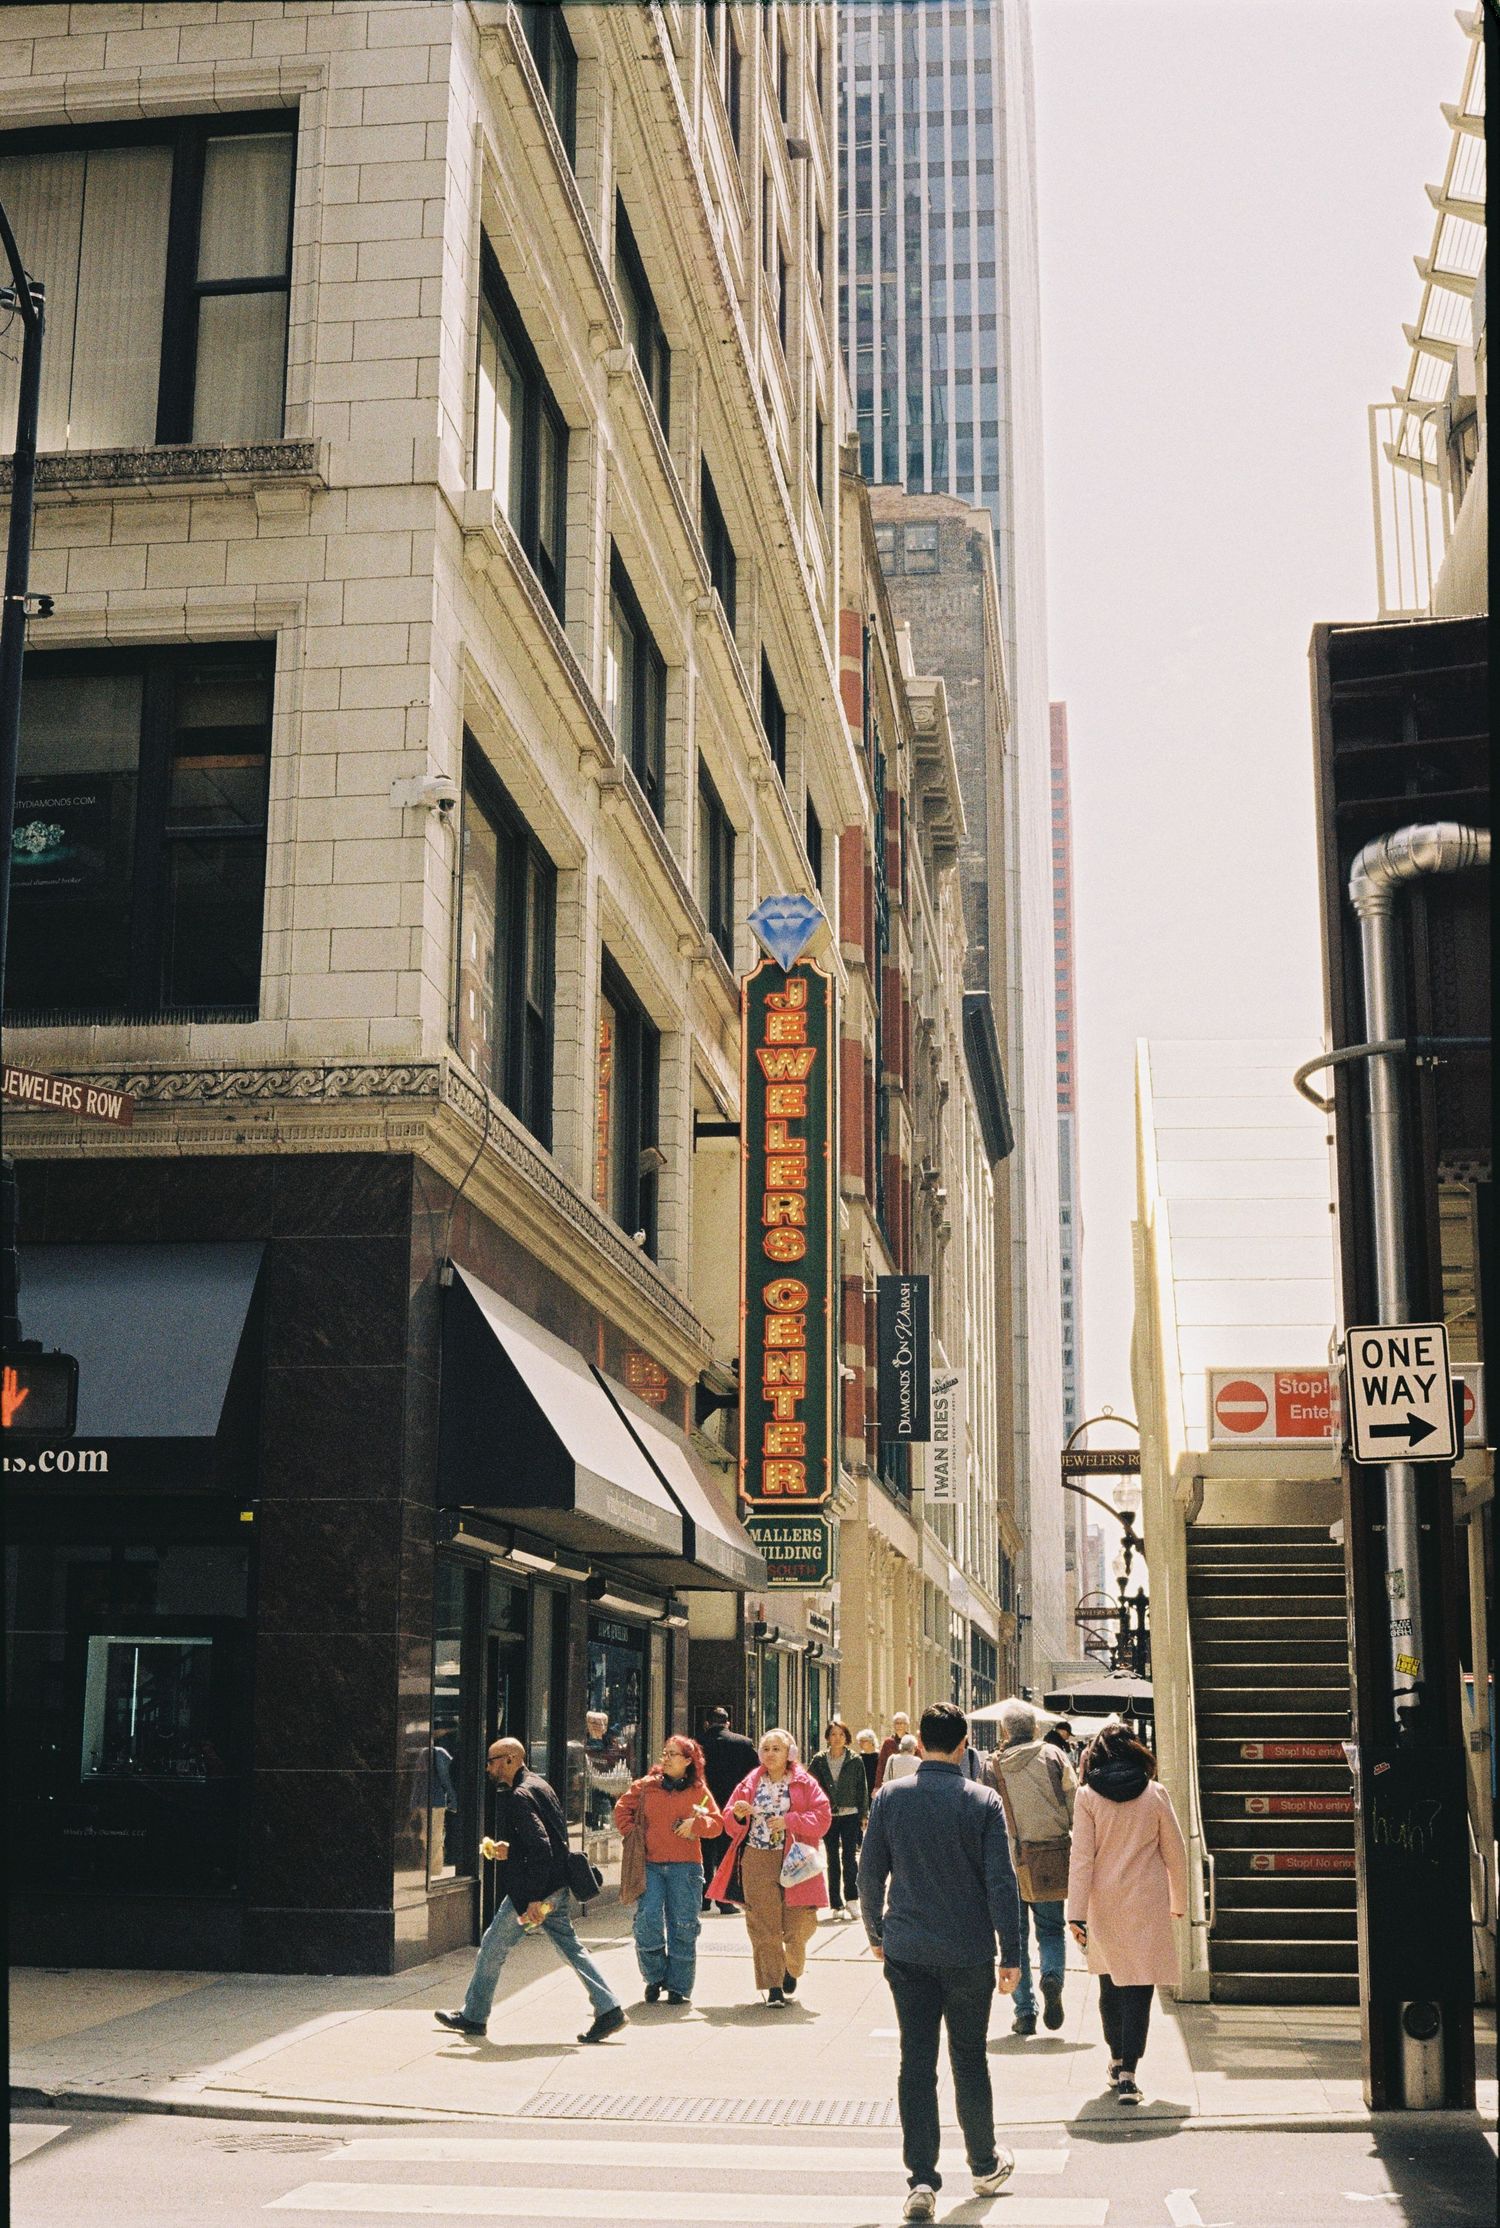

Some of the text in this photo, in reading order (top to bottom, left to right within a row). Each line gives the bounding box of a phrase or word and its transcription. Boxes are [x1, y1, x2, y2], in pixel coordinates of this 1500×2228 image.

[1, 1069, 122, 1119] JEWELERS ROW
[756, 978, 817, 1494] JEWELERS CENTER
[1362, 1336, 1435, 1369] ONE
[1279, 1378, 1328, 1398] Stop!
[1361, 1373, 1437, 1406] WAY
[898, 1370, 912, 1434] DIAMONDS
[1290, 1404, 1330, 1419] Ente
[934, 1398, 949, 1441] RIES
[3, 1450, 109, 1473] s.com
[1061, 1455, 1125, 1467] JEWELERS
[934, 1448, 949, 1497] IWAN
[749, 1528, 822, 1542] MALLERS
[758, 1546, 822, 1560] UILDING
[1274, 1747, 1342, 1758] Stop! No entry
[1280, 1800, 1350, 1812] Stop! No entry
[1287, 1857, 1313, 1868] Stop!
[1316, 1858, 1331, 1867] No
